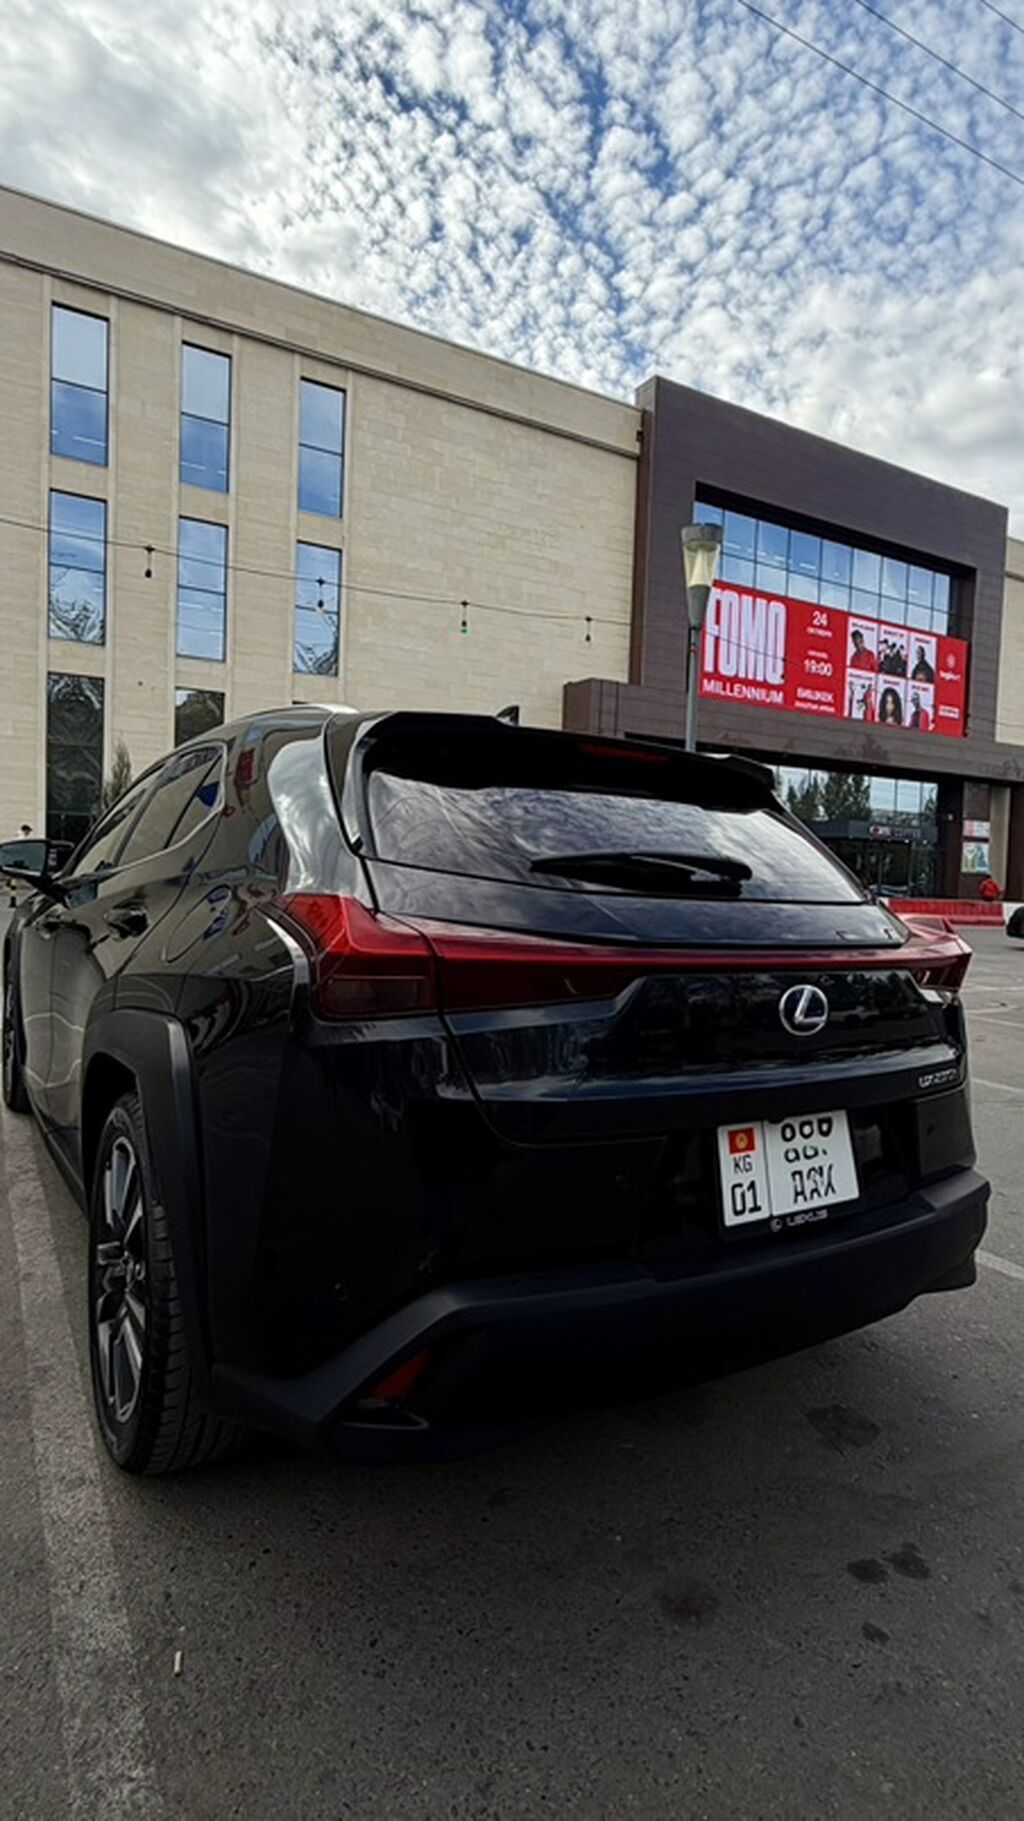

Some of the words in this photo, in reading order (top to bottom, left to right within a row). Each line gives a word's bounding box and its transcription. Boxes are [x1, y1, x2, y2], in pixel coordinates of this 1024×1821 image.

[812, 610, 828, 627] 24
[704, 587, 787, 685] FOMO
[804, 659, 833, 677] 19:00
[702, 678, 784, 705] MILLENNIUM
[733, 1154, 753, 1175] KG
[731, 1179, 762, 1216] 01
